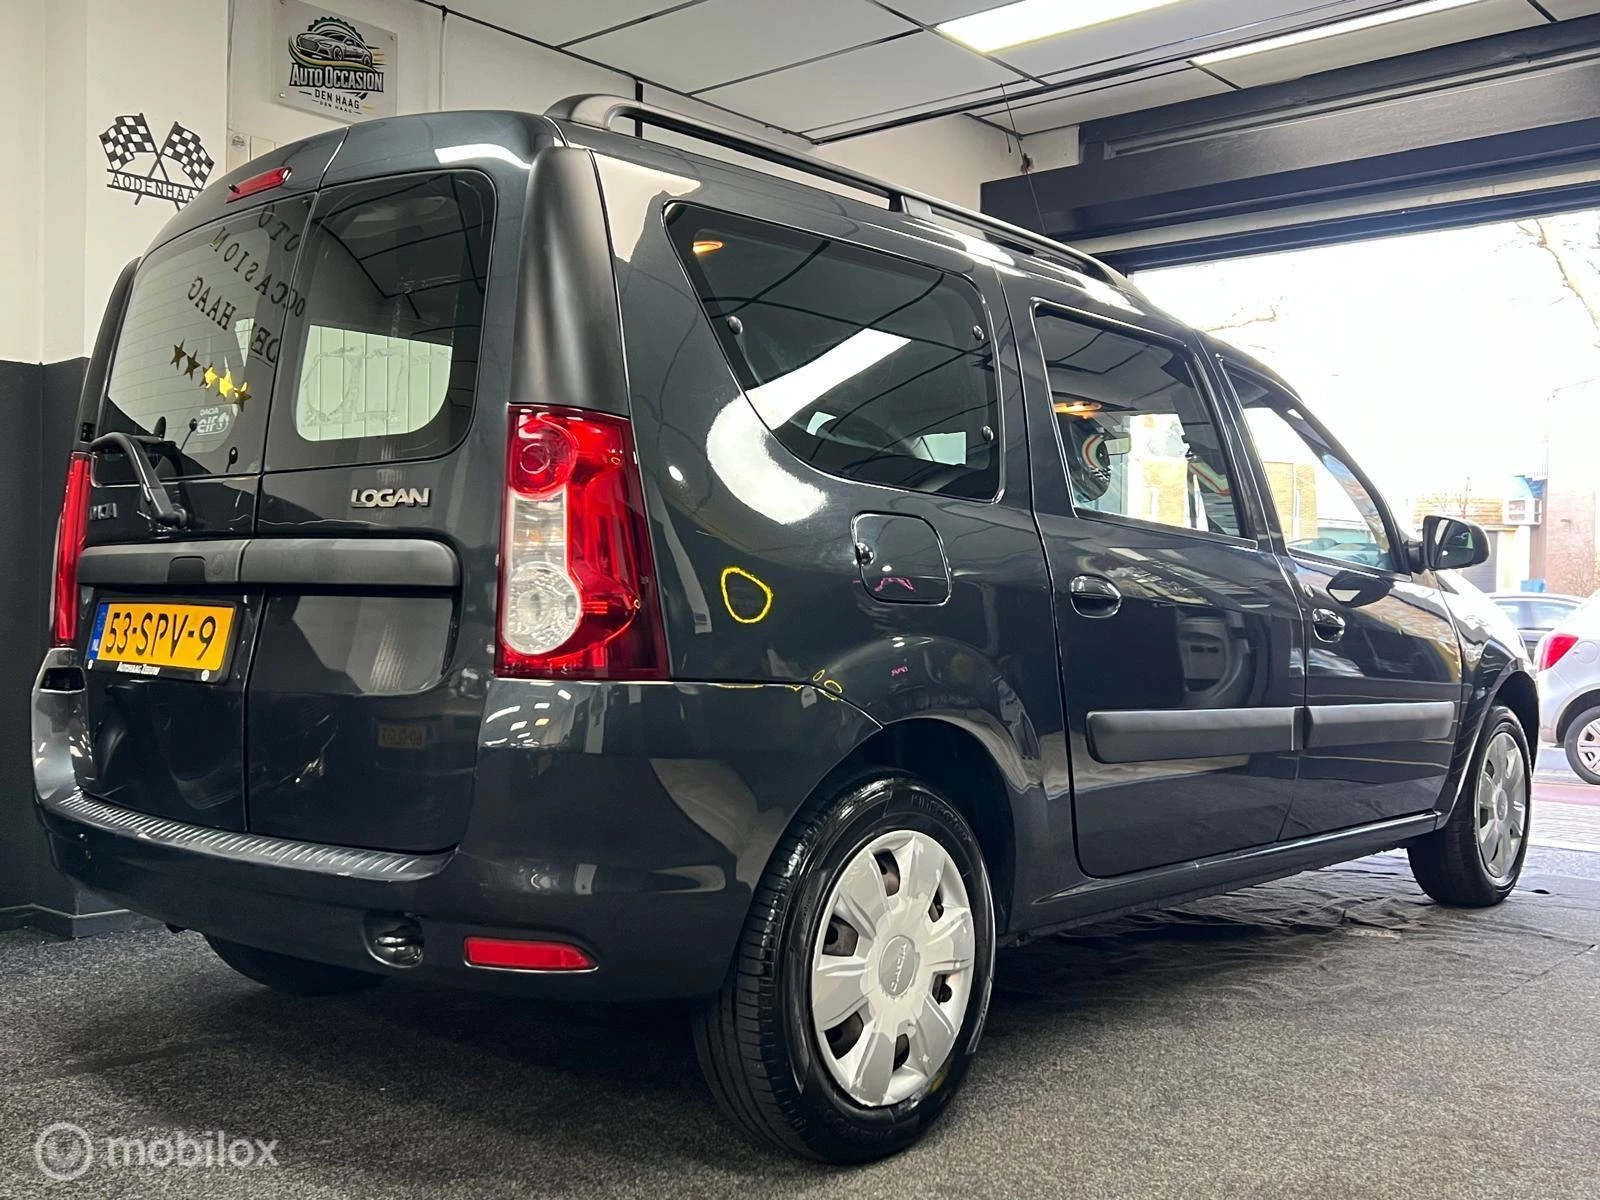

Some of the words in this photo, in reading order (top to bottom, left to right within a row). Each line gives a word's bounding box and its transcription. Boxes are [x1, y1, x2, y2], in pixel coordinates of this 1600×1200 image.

[290, 64, 323, 87] AUTO
[324, 66, 384, 92] OCCASION
[314, 89, 333, 101] DEN
[335, 94, 360, 110] HAAG
[111, 172, 196, 203] AODENHAA
[351, 487, 431, 508] LOGAN
[105, 612, 217, 661] 53-SPV-9
